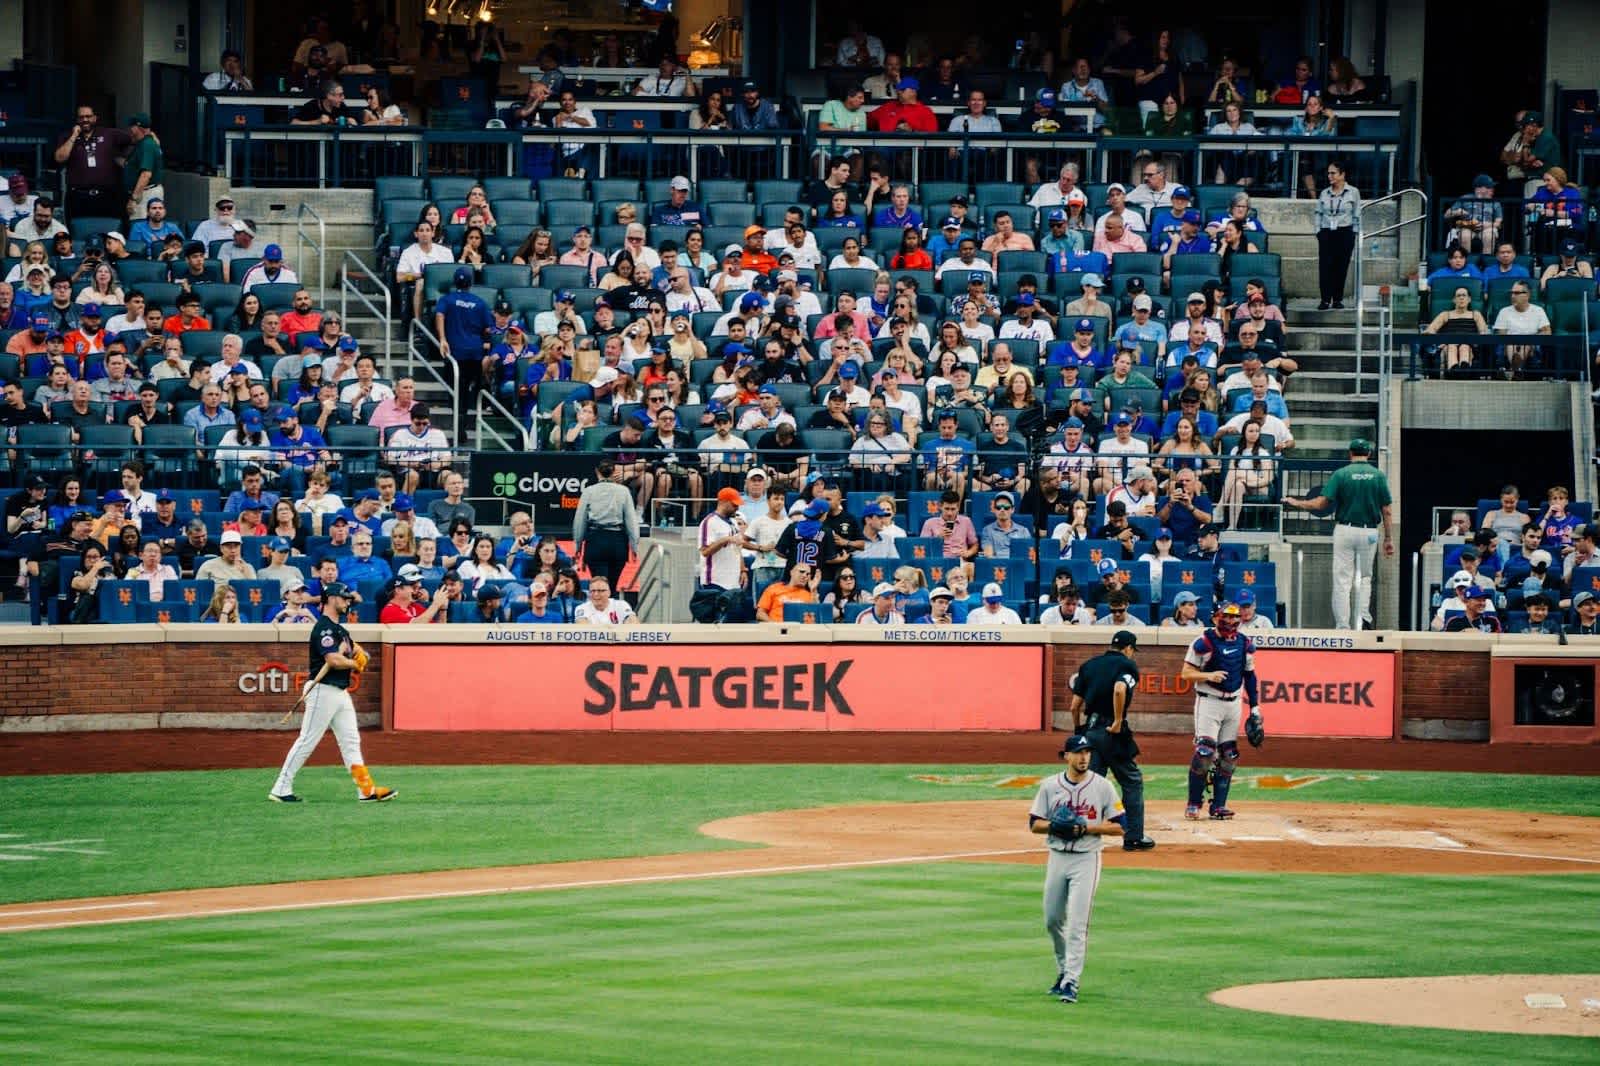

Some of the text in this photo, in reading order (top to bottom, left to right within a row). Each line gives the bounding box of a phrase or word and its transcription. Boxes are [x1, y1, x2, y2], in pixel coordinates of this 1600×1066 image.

[518, 472, 588, 493] clover
[796, 541, 819, 567] 12
[486, 631, 672, 642] AUGUST 18 FOOTBALL JERSEY
[884, 630, 1003, 641] METS.COM/TICKETS
[1250, 635, 1354, 648] TS.COM/TICKETS
[238, 667, 289, 694] citi
[583, 659, 855, 717] SEATGEEK
[1139, 672, 1191, 694] IELD
[1255, 681, 1376, 708] EATGEEK
